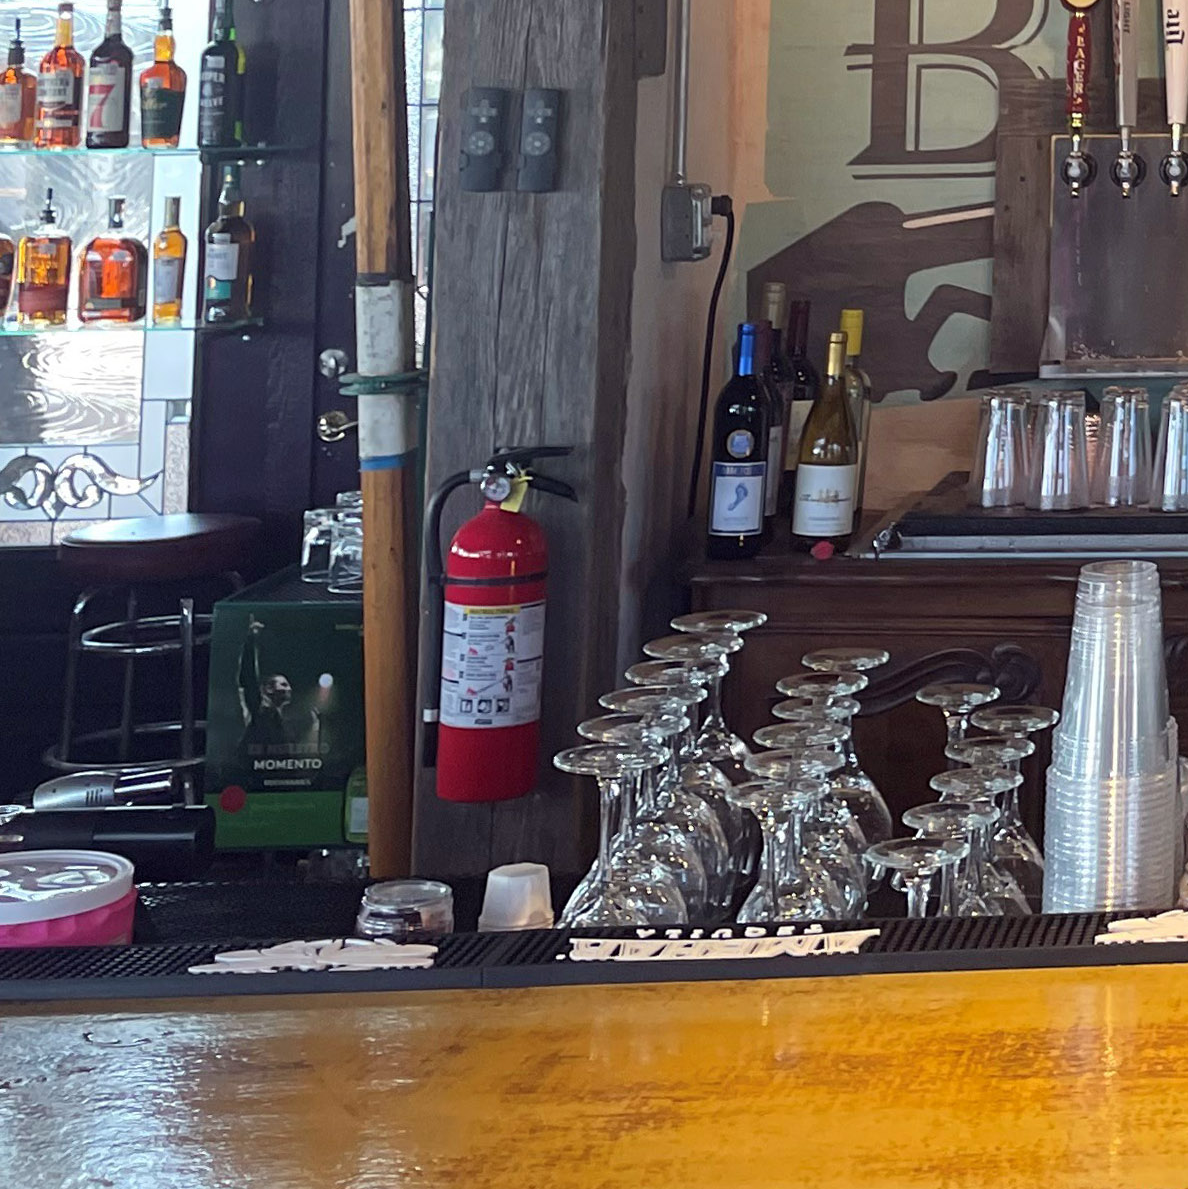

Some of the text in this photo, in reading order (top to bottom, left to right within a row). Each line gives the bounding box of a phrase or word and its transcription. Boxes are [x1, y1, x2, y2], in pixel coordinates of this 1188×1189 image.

[1166, 9, 1185, 45] Lite
[1074, 35, 1086, 94] LAGER
[253, 759, 322, 771] MOMENTO
[635, 923, 824, 939] TEQUILA
